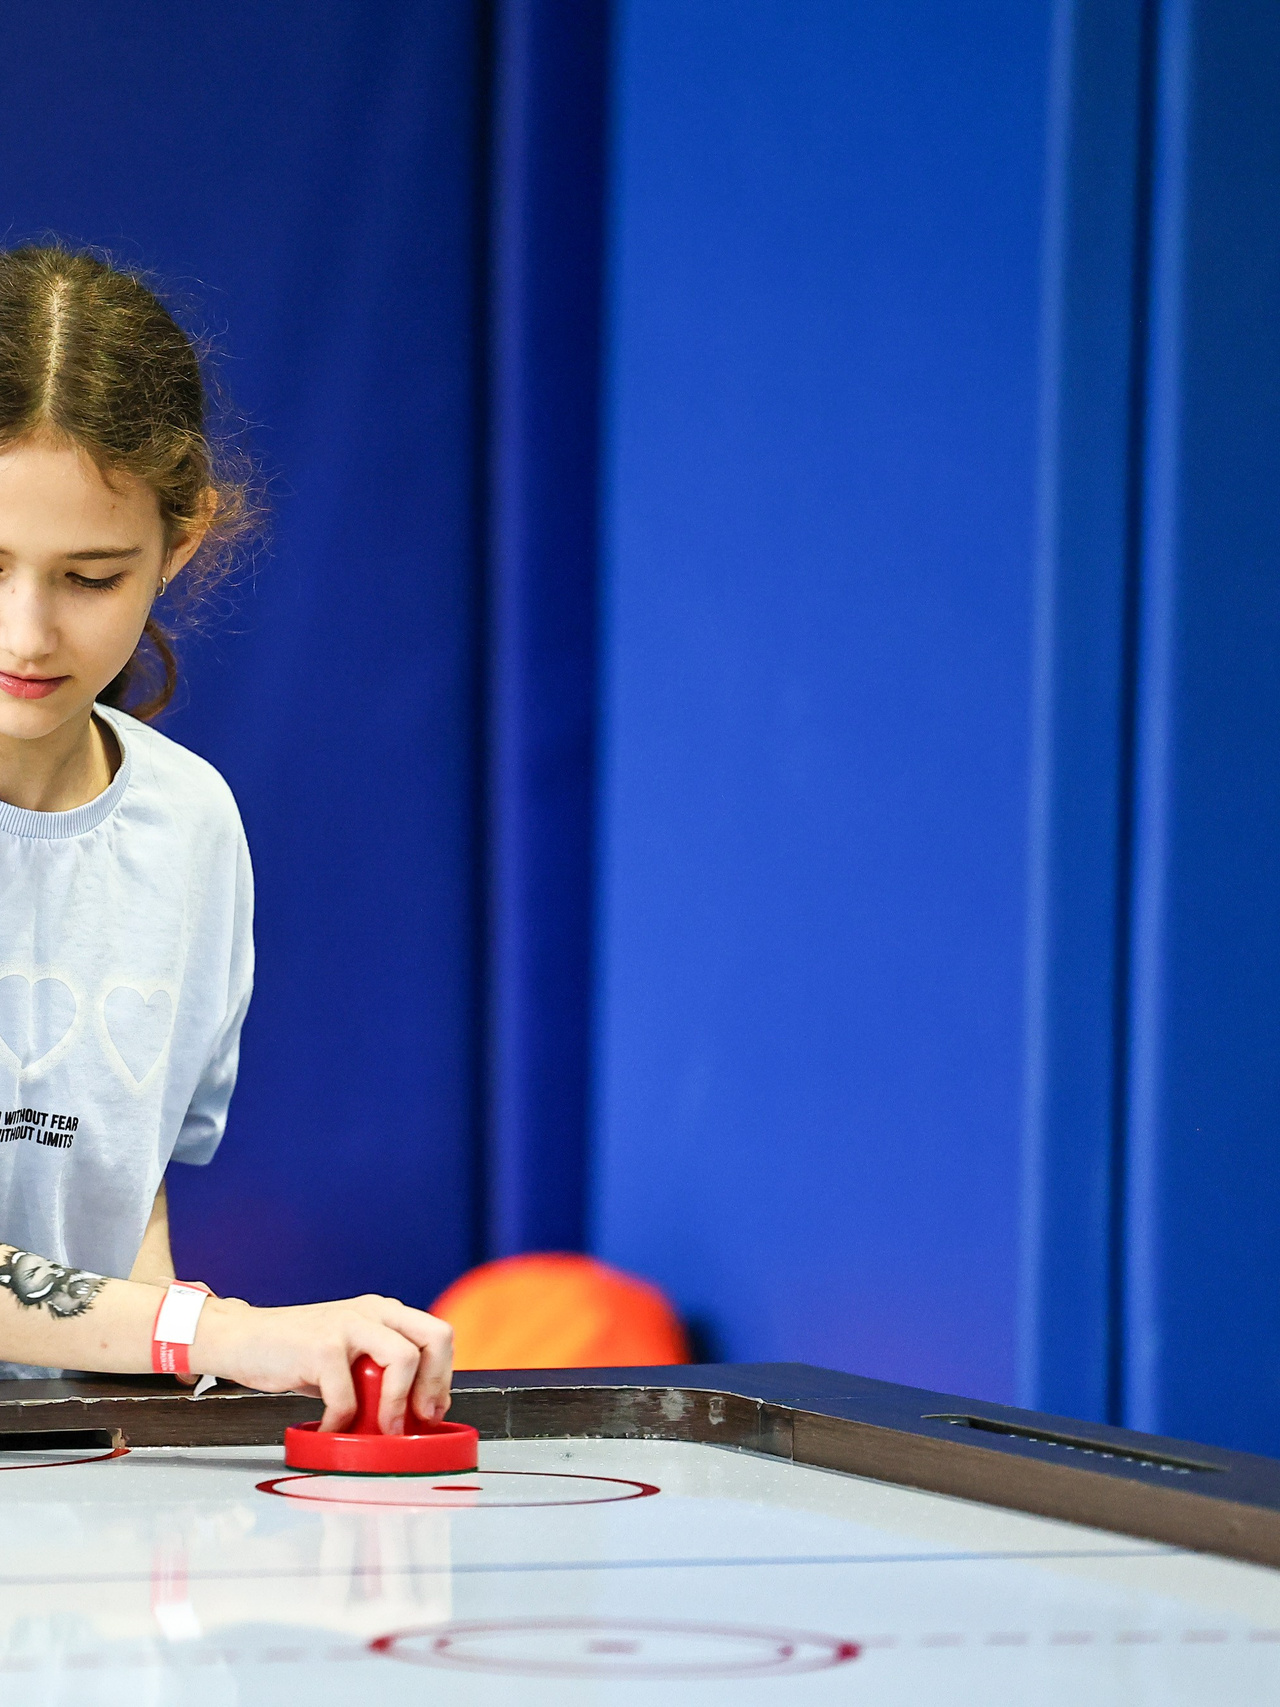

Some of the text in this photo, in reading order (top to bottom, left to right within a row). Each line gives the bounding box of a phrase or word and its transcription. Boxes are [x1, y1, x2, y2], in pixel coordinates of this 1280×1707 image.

[4, 1108, 48, 1126] WITHOUT
[50, 1114, 79, 1131] FEAR
[36, 1130, 74, 1148] LIMITS
